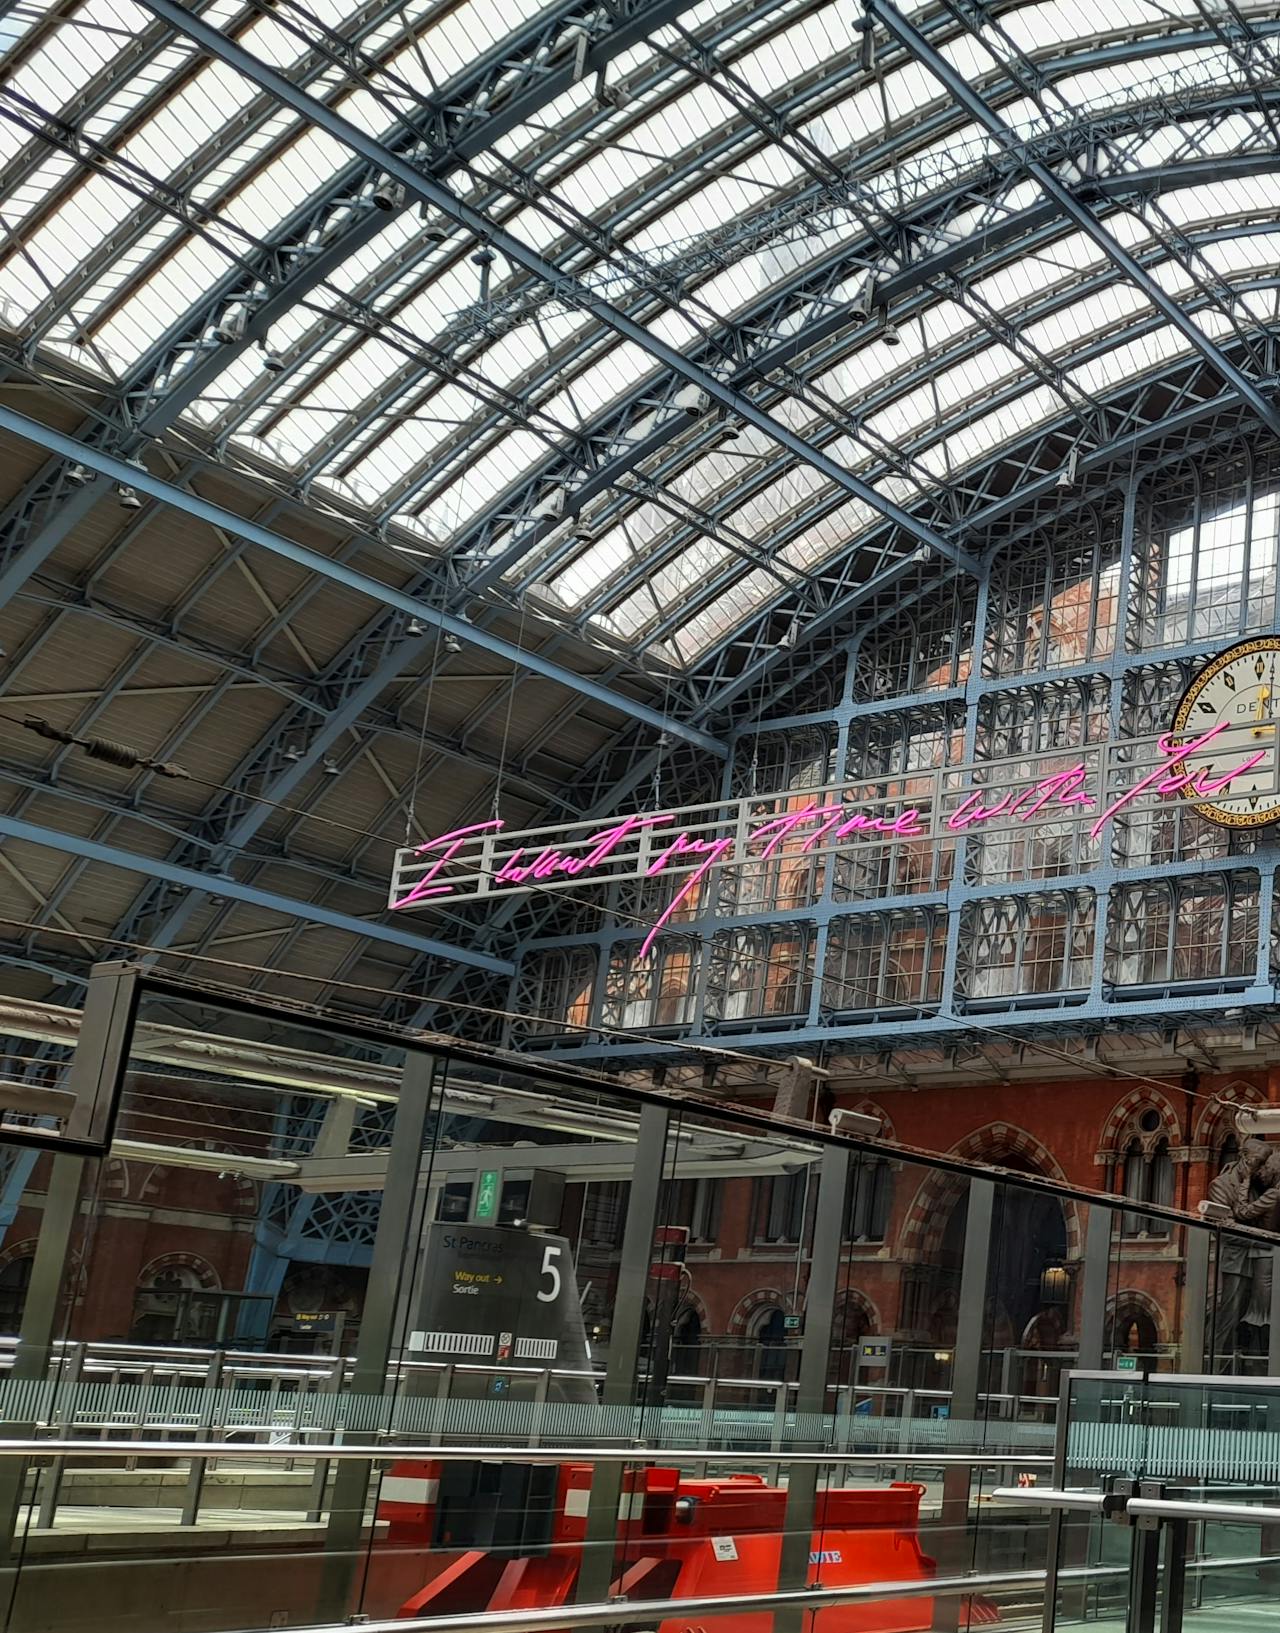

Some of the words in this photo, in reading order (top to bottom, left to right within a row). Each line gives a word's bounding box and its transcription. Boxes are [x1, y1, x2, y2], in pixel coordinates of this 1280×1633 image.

[1236, 697, 1280, 714] DENT
[390, 819, 505, 910] I
[443, 1235, 456, 1249] St
[459, 1236, 504, 1254] Pancras
[454, 1270, 475, 1284] Way
[475, 1274, 490, 1283] out
[536, 1245, 562, 1303] 5
[452, 1283, 480, 1296] Sortie
